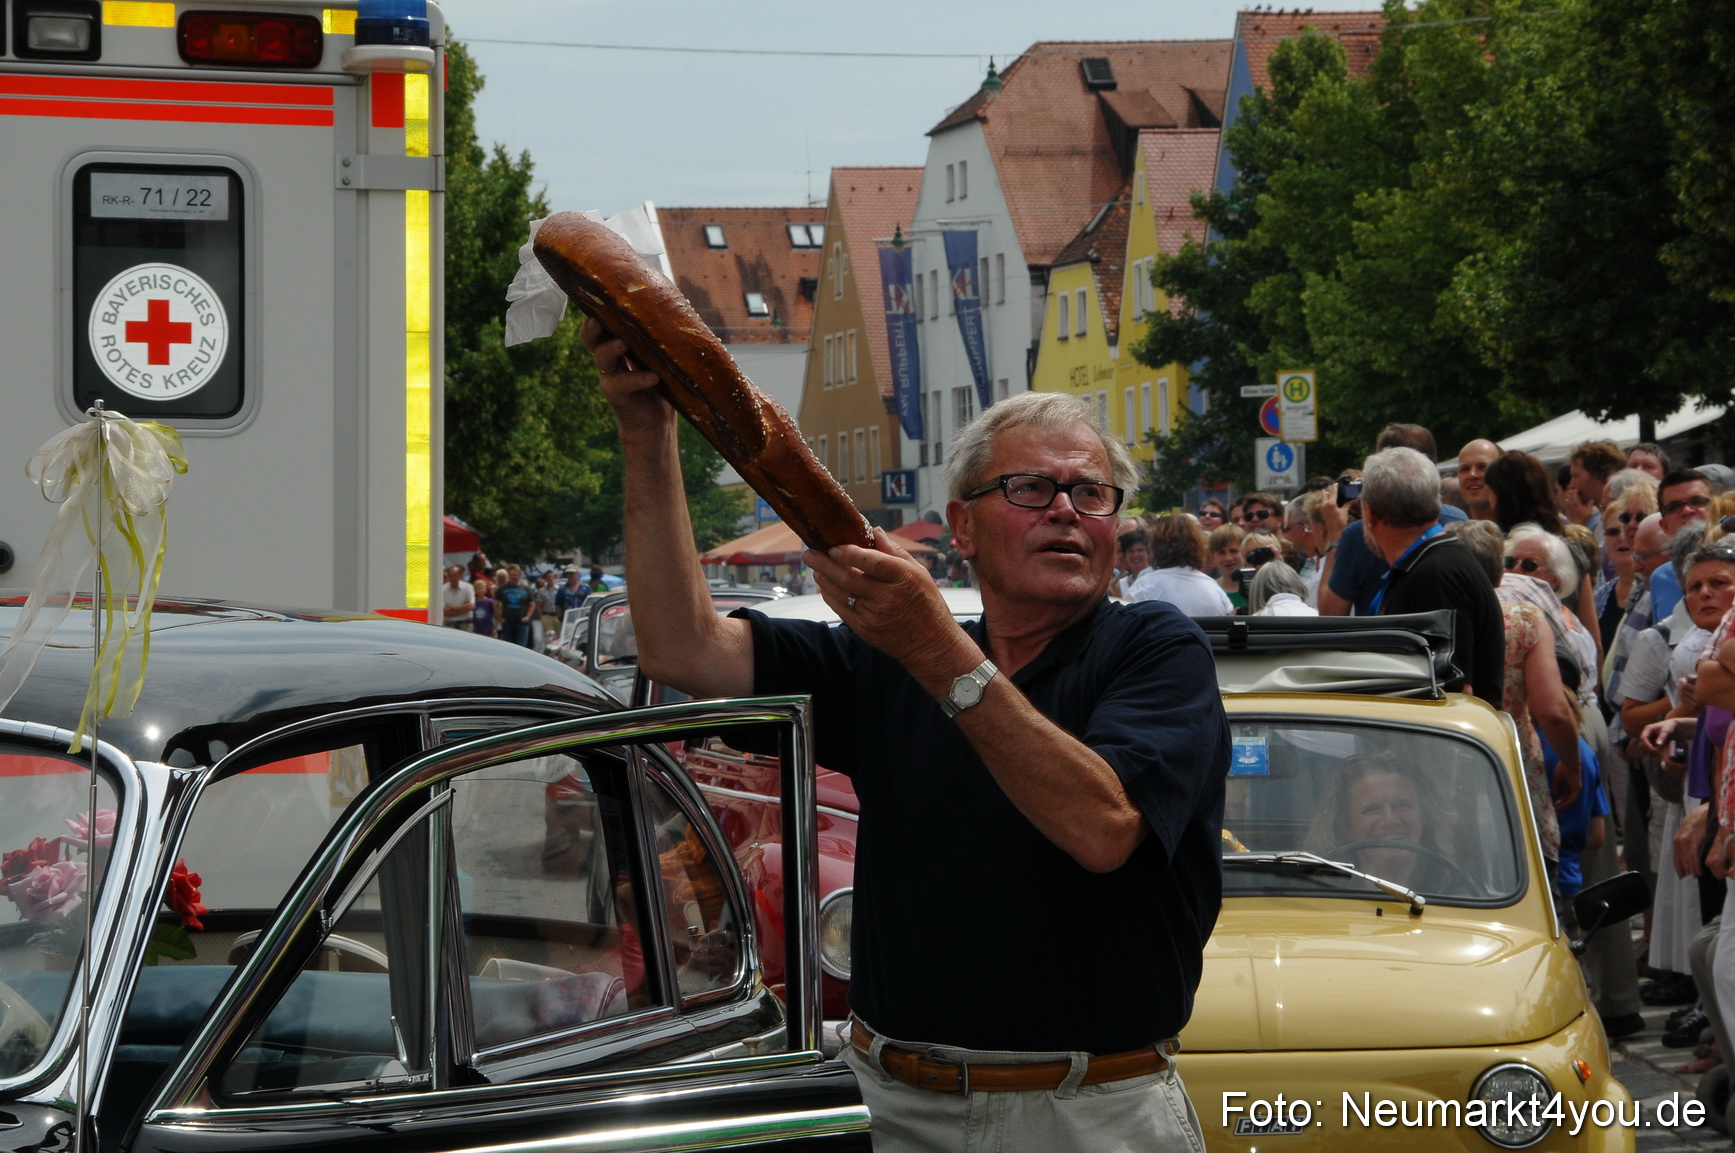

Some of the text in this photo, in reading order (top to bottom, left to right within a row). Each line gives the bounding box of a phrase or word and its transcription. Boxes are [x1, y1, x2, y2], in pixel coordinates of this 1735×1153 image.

[140, 187, 163, 205] 71
[172, 188, 179, 206] /
[186, 188, 211, 207] 22
[102, 274, 215, 326] BAYERISCHES
[101, 335, 216, 389] ROTES KREUZ
[1069, 364, 1089, 388] HOTEL
